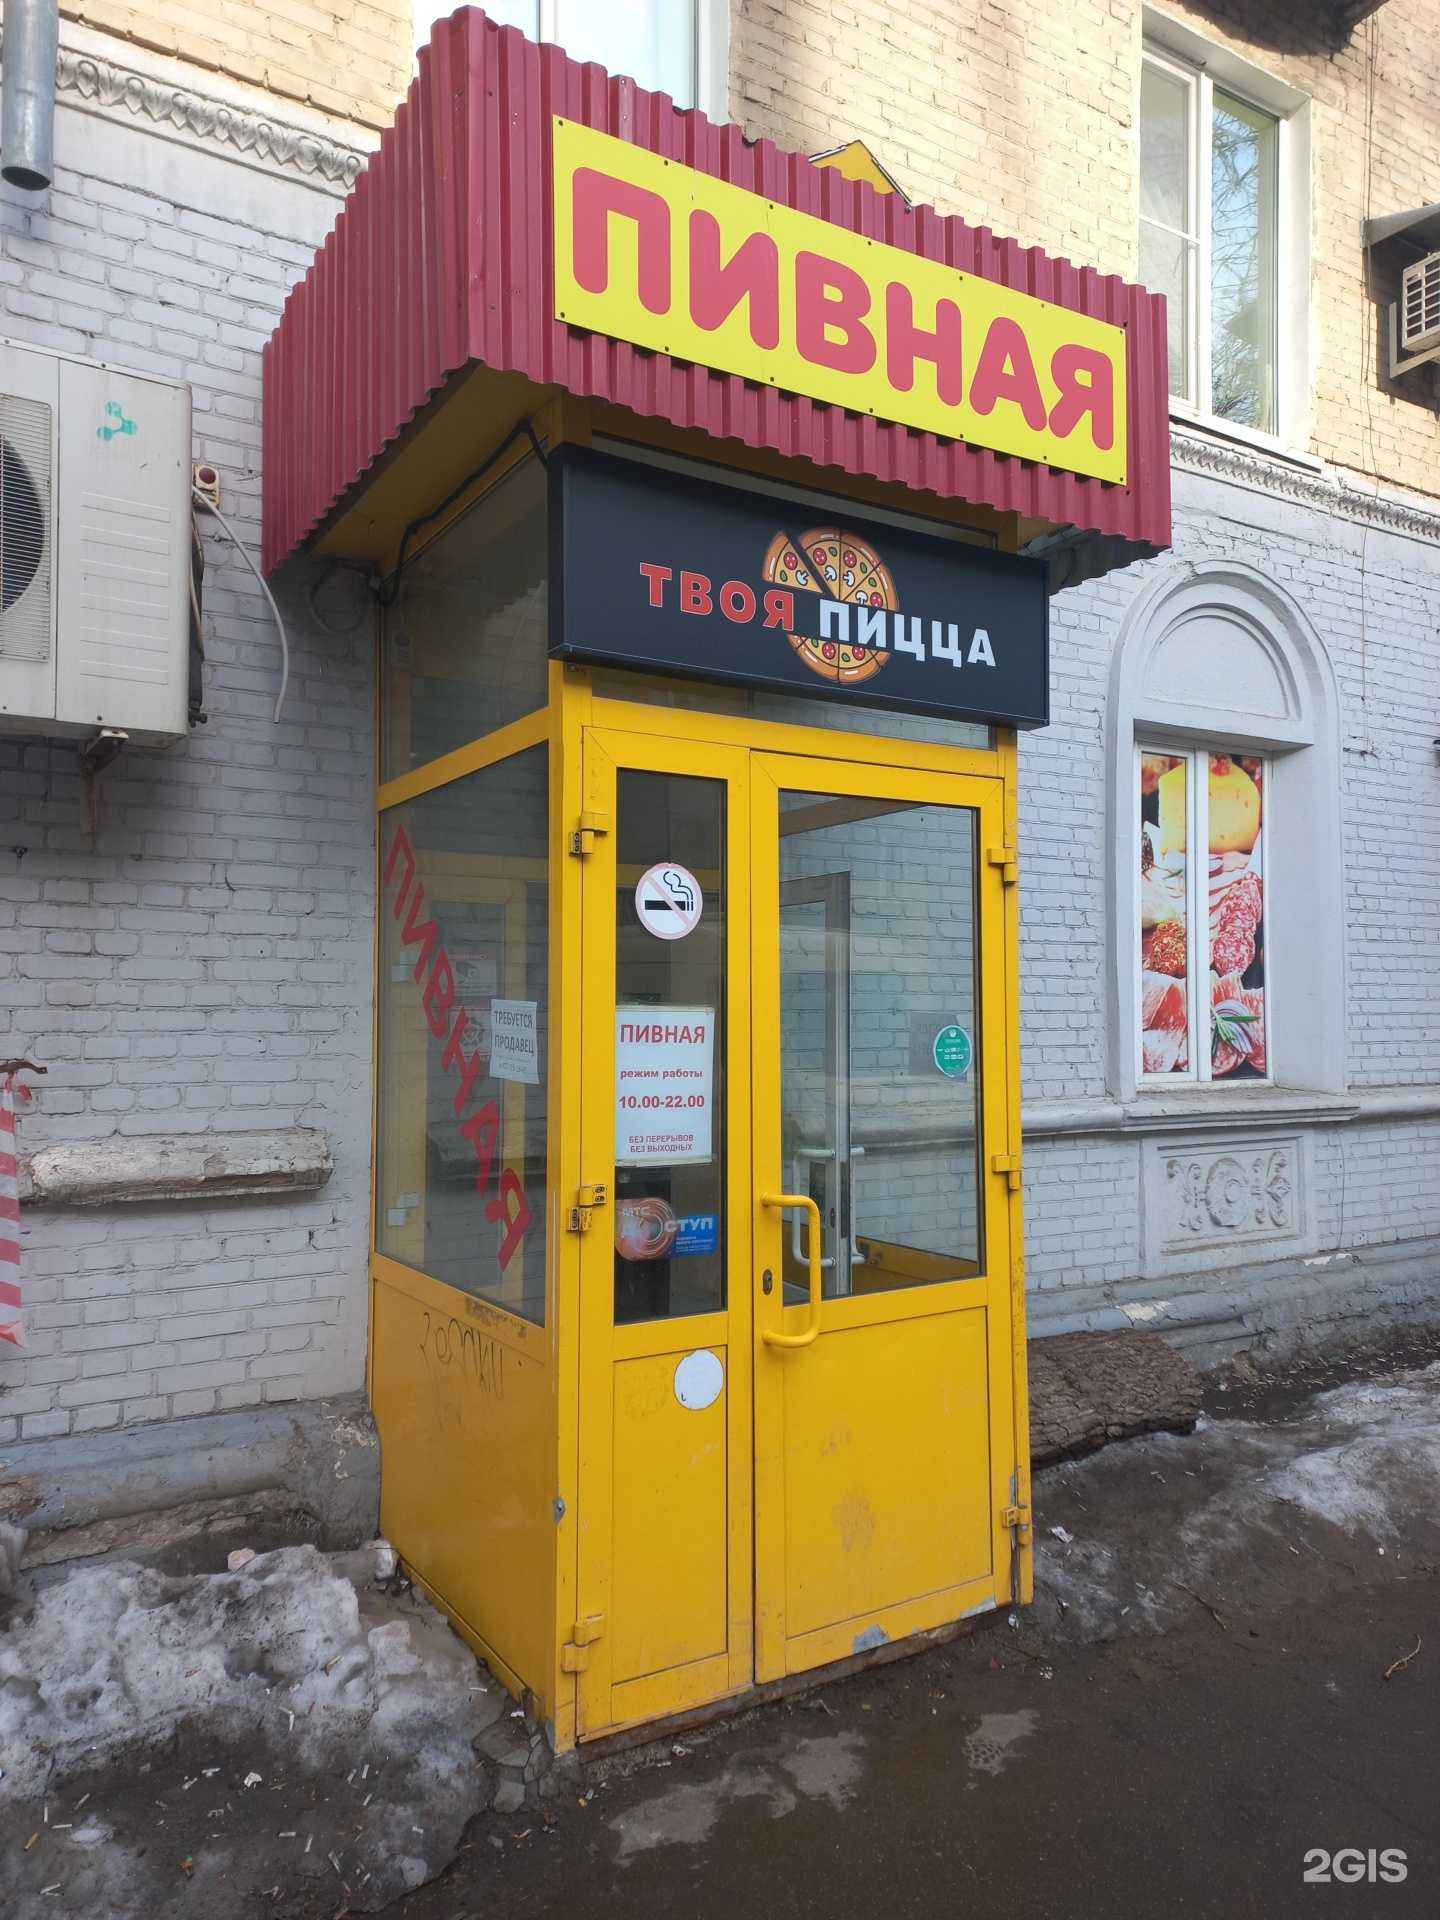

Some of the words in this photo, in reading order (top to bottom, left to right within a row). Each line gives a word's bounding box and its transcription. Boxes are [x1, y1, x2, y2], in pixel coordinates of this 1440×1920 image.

[572, 167, 1114, 451] ПИВНАЯ
[640, 562, 795, 631] ТВОЯ
[819, 599, 997, 668] ПИЦЦА
[494, 1010, 534, 1029] ТРЕБУЕТСЯ
[620, 1024, 705, 1044] ПИВНАЯ
[383, 824, 533, 1272] ПИВНАЯ
[494, 1035, 535, 1054] ПРОДАВЕЦ
[620, 1069, 659, 1080] режим
[663, 1068, 703, 1080] работы
[618, 1095, 705, 1109] 10.00-22.00
[628, 1135, 644, 1144] БЕЗ
[645, 1134, 694, 1143] ПЕРЕРЫВОВ
[630, 1145, 646, 1153] БЕЗ
[647, 1144, 693, 1153] ВЫХОДНЫХ
